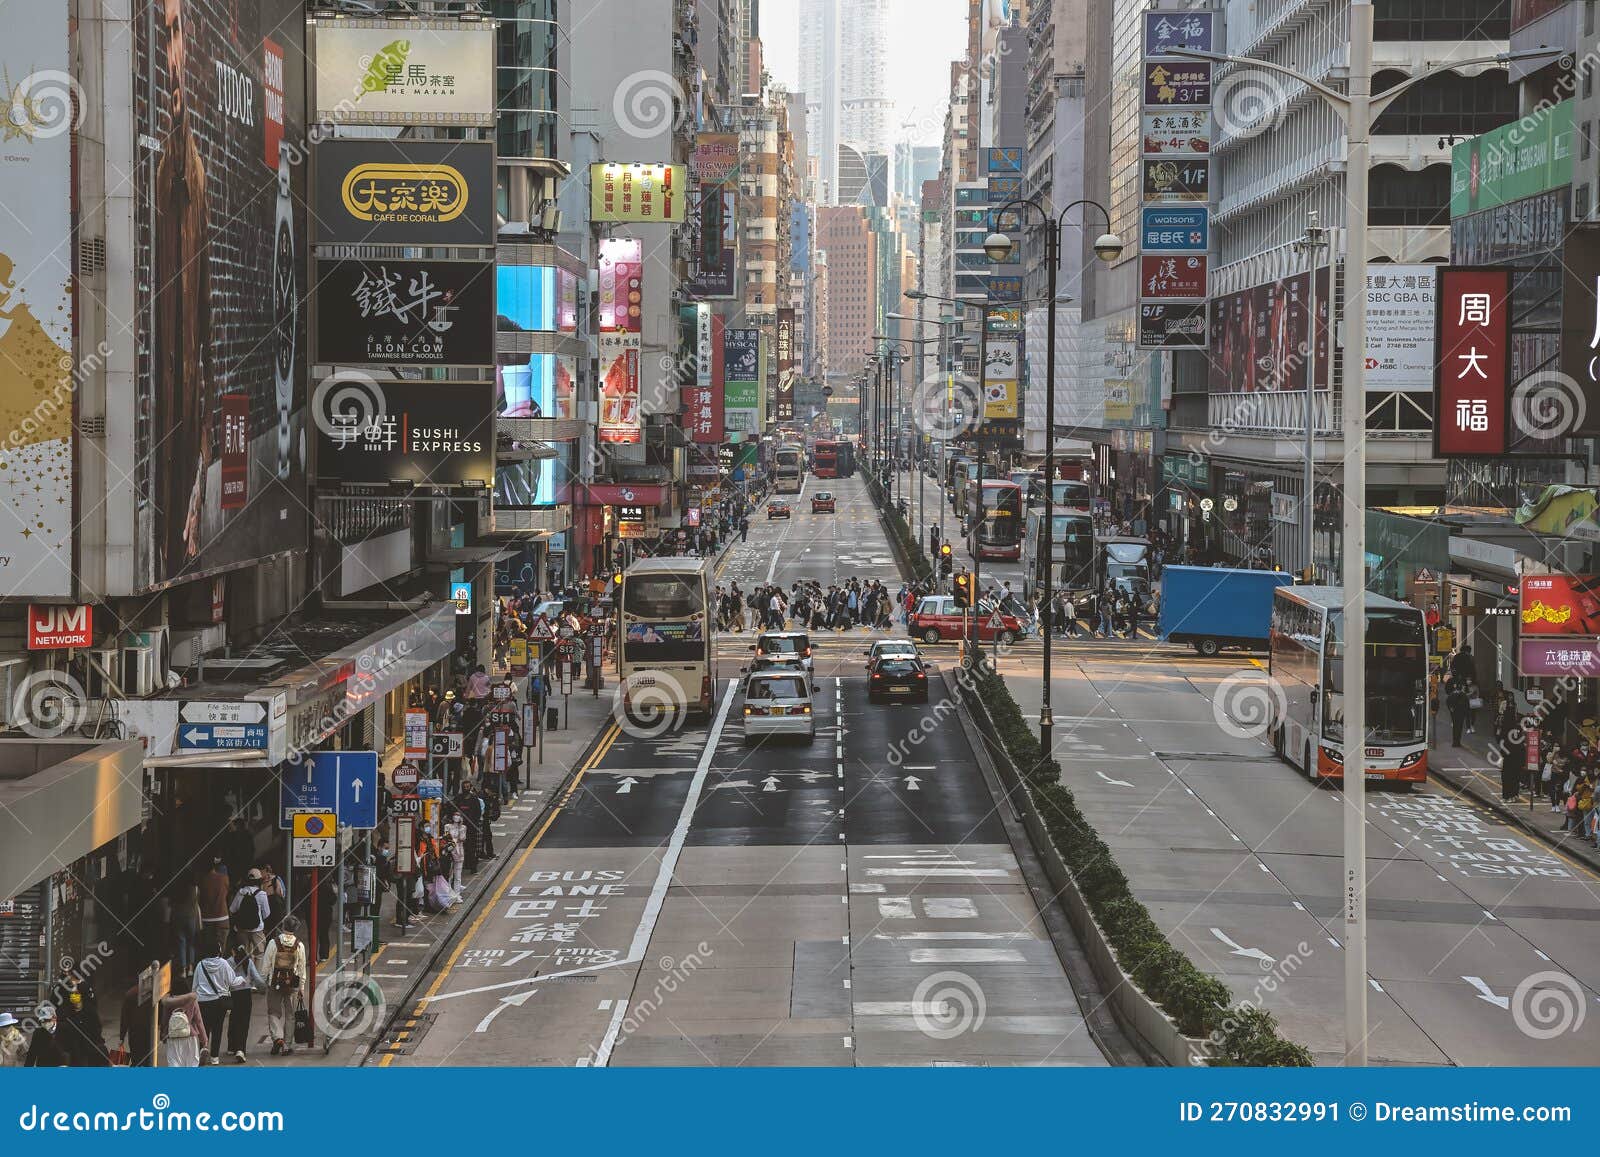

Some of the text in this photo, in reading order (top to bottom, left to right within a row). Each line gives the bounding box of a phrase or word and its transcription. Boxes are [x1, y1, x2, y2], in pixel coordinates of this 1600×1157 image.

[1154, 17, 1204, 40] 金福
[215, 60, 254, 127] TUDOR
[1179, 89, 1205, 102] 3/F
[1183, 169, 1206, 184] 1/F
[373, 214, 438, 223] CAFE DE CORAL
[1154, 215, 1195, 224] watsons
[1393, 292, 1419, 303] GBA
[1142, 305, 1164, 317] 5/F
[367, 343, 444, 353] IRON COW
[1456, 293, 1491, 432] 周大福
[328, 414, 398, 451] 爭鮮
[412, 428, 458, 439] SUSHI
[412, 441, 482, 452] EXPRESS
[35, 605, 87, 633] JM
[35, 635, 86, 646] NETWORK
[222, 703, 241, 711] Street
[491, 713, 511, 723] S11
[302, 784, 318, 792] Bus
[393, 799, 418, 812] S10
[320, 855, 333, 865] 12
[1449, 851, 1563, 865] STOP
[528, 870, 625, 882] BUS
[1470, 862, 1573, 878] BUS
[507, 884, 630, 897] LANE
[503, 899, 608, 919] 巴士
